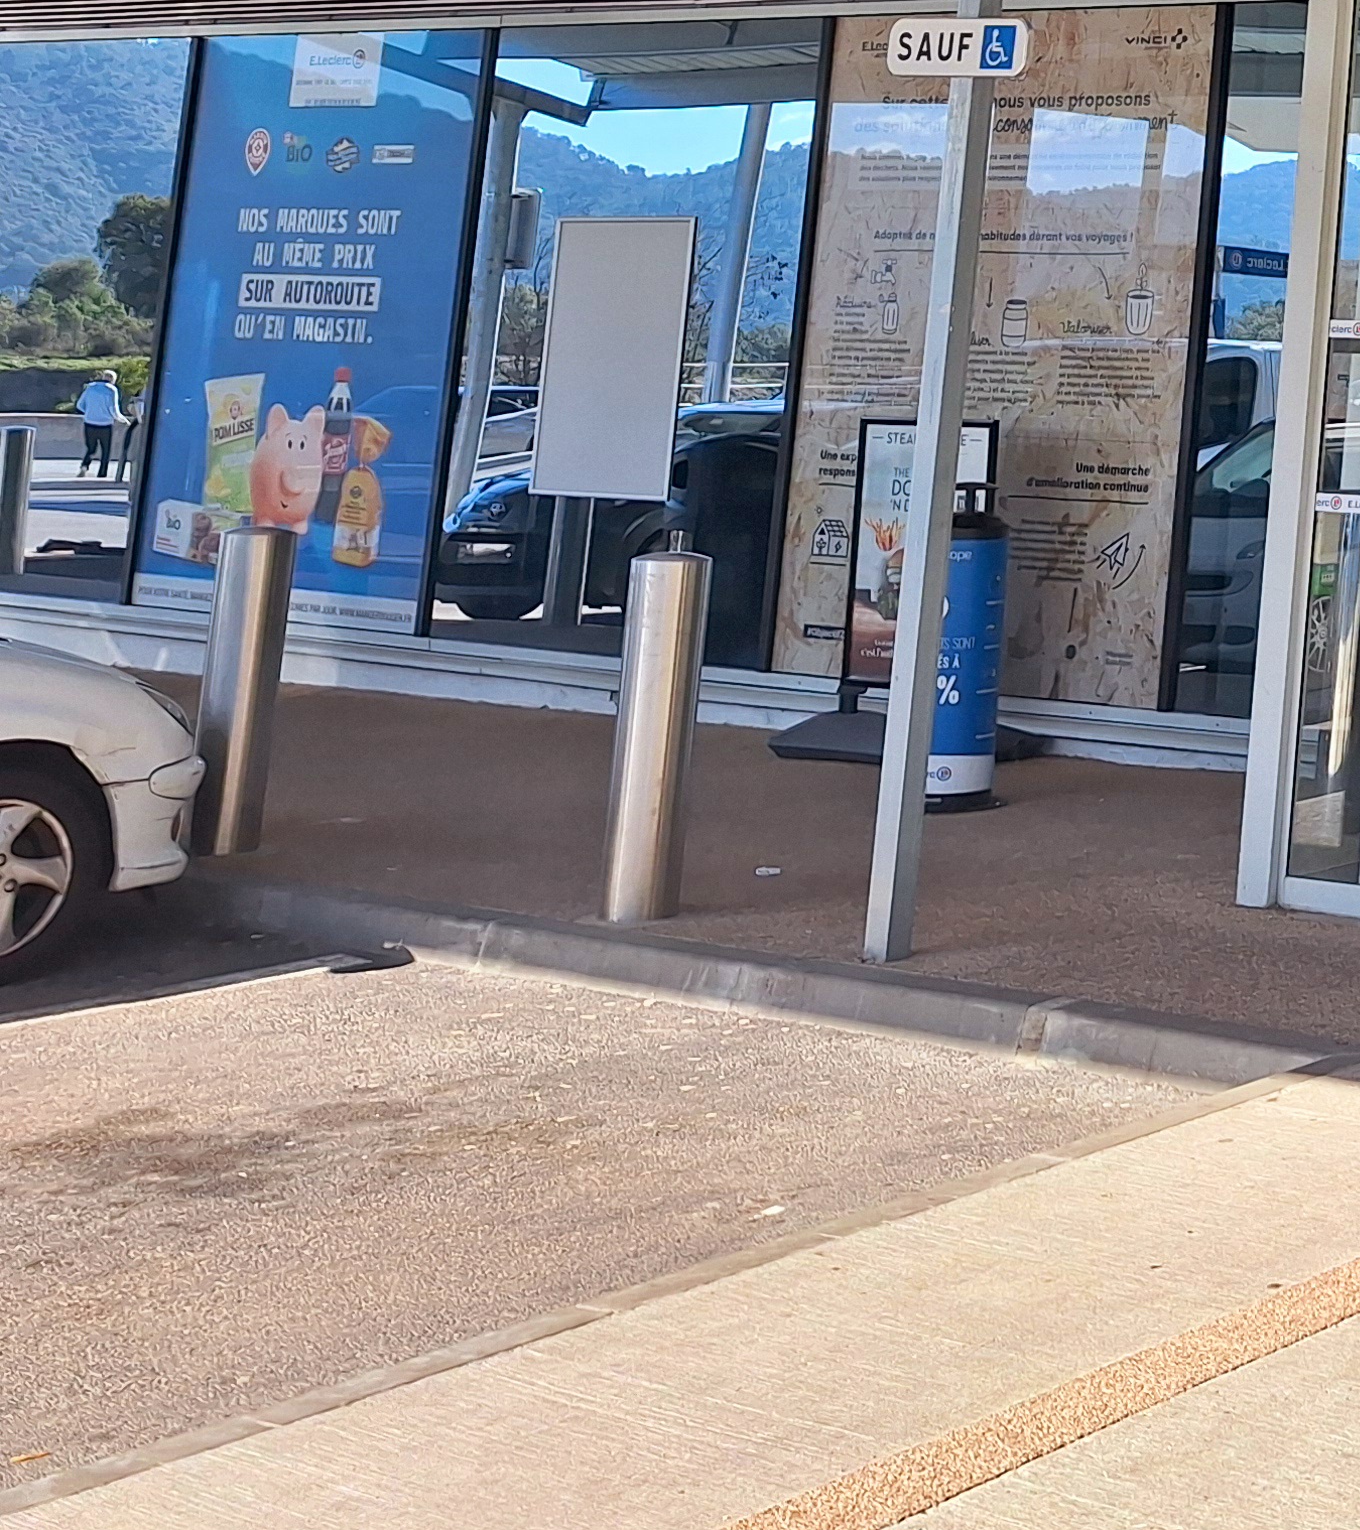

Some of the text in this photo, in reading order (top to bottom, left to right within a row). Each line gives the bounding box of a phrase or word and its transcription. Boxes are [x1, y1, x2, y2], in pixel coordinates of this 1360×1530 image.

[896, 31, 974, 62] SAUF
[1125, 36, 1168, 46] VINCI
[309, 55, 351, 67] E.Leclerc
[882, 96, 903, 110] Sur
[1029, 96, 1064, 108] vous
[1068, 94, 1151, 112] proposons
[237, 208, 402, 235] NOS MARQUES SONT
[873, 229, 913, 243] Adoptez
[915, 230, 927, 241] de
[1065, 232, 1083, 242] vos
[1085, 232, 1126, 245] voyages
[252, 238, 376, 269] AU MÊME PRIX
[244, 279, 376, 307] SUR AUTOROUTE
[234, 313, 374, 344] QU'EN MAGASIN.
[1331, 324, 1353, 333] clerc
[886, 432, 917, 445] STEA
[820, 449, 838, 462] Une
[819, 466, 857, 478] respons
[1075, 462, 1150, 477] Une démarche
[1102, 480, 1149, 493] continue
